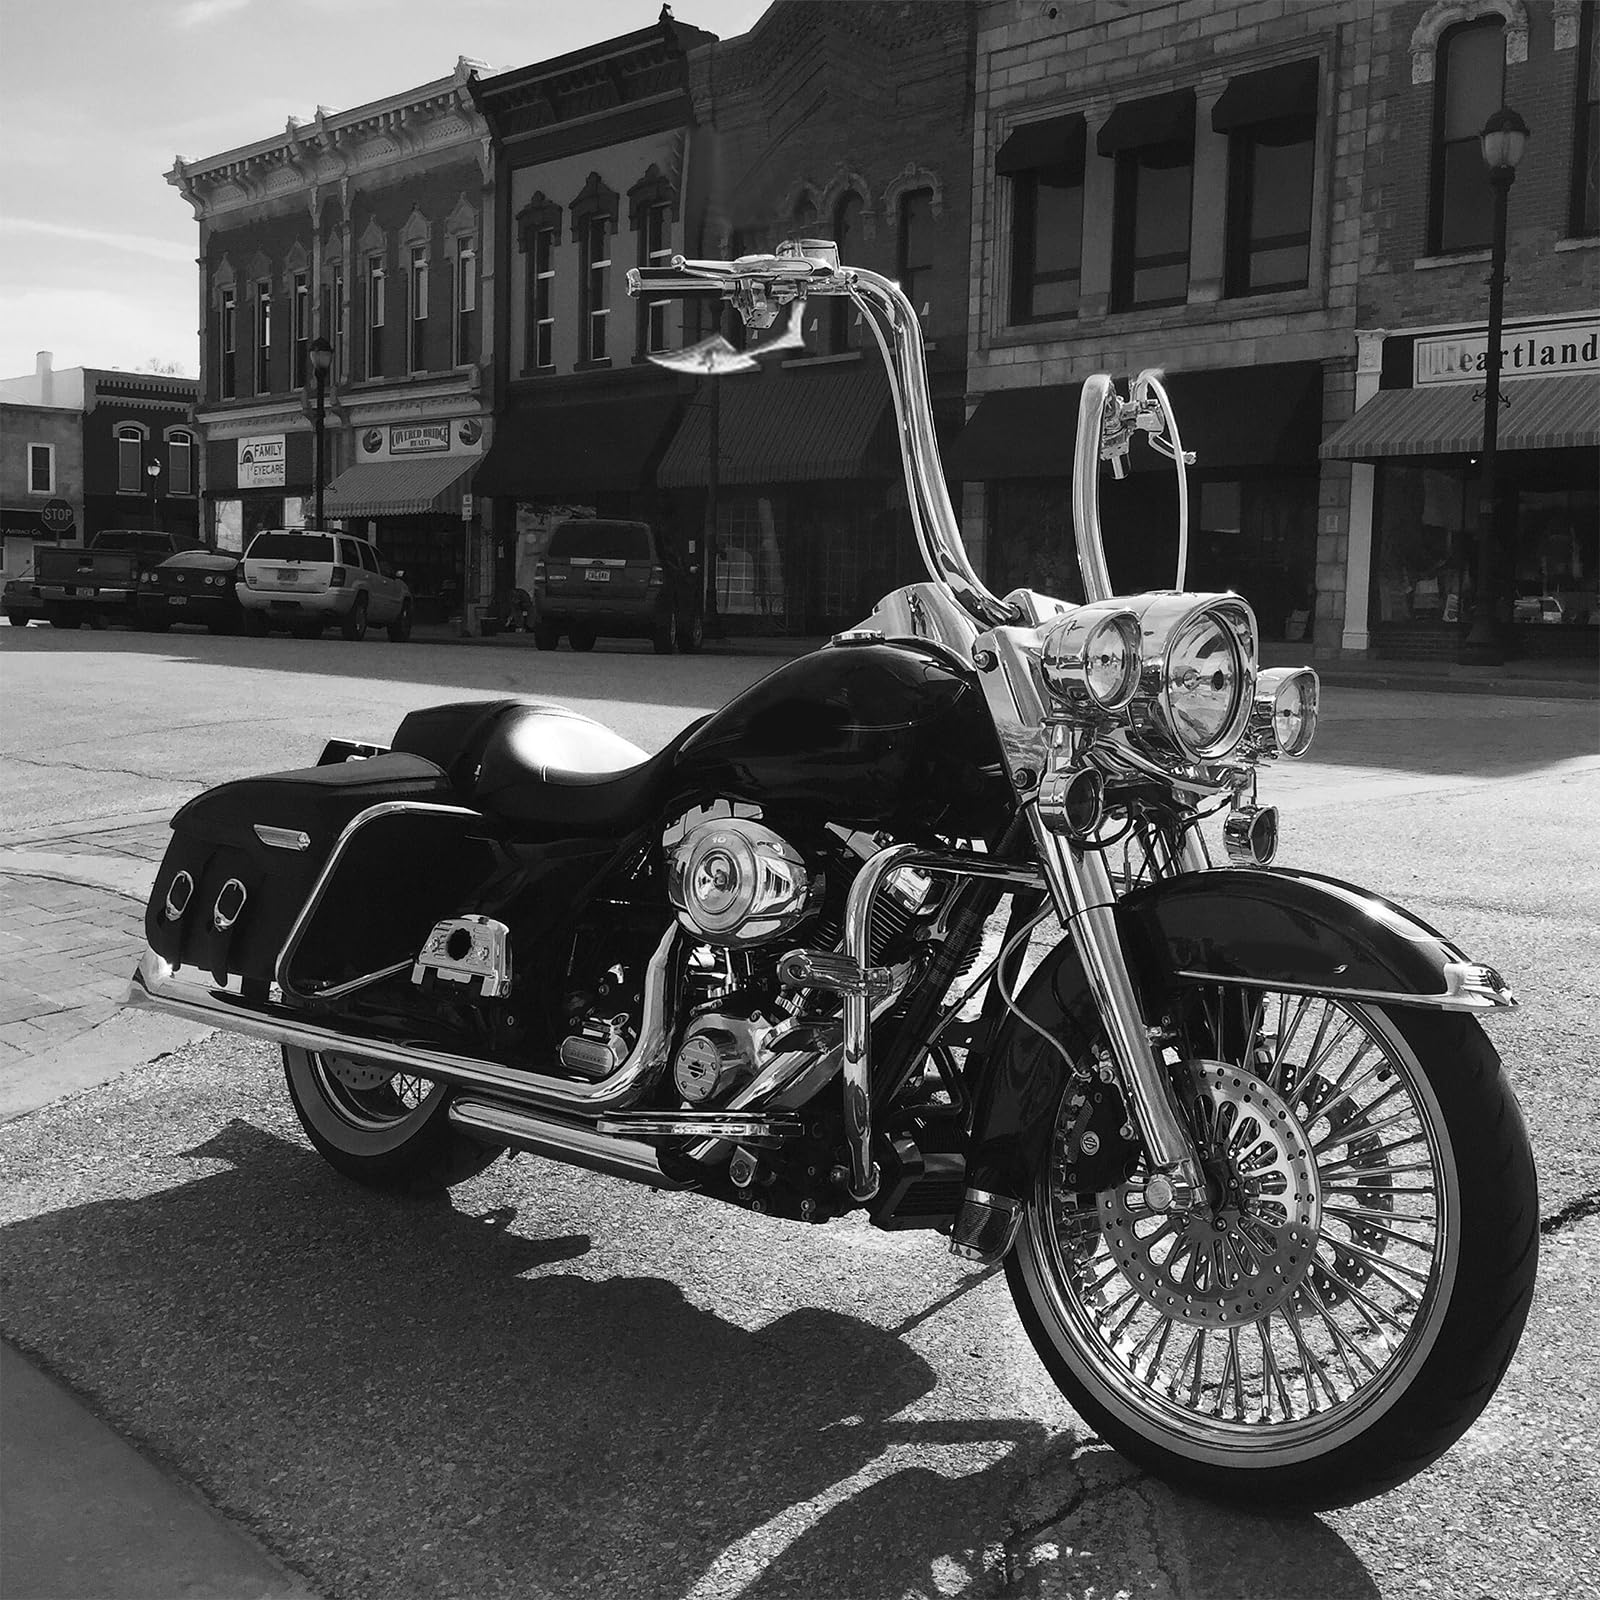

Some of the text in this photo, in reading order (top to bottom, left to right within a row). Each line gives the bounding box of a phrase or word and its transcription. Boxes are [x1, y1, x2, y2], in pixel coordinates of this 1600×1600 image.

[254, 444, 283, 458] FAMILY
[254, 464, 284, 476] EYECARE
[44, 508, 72, 521] STOP
